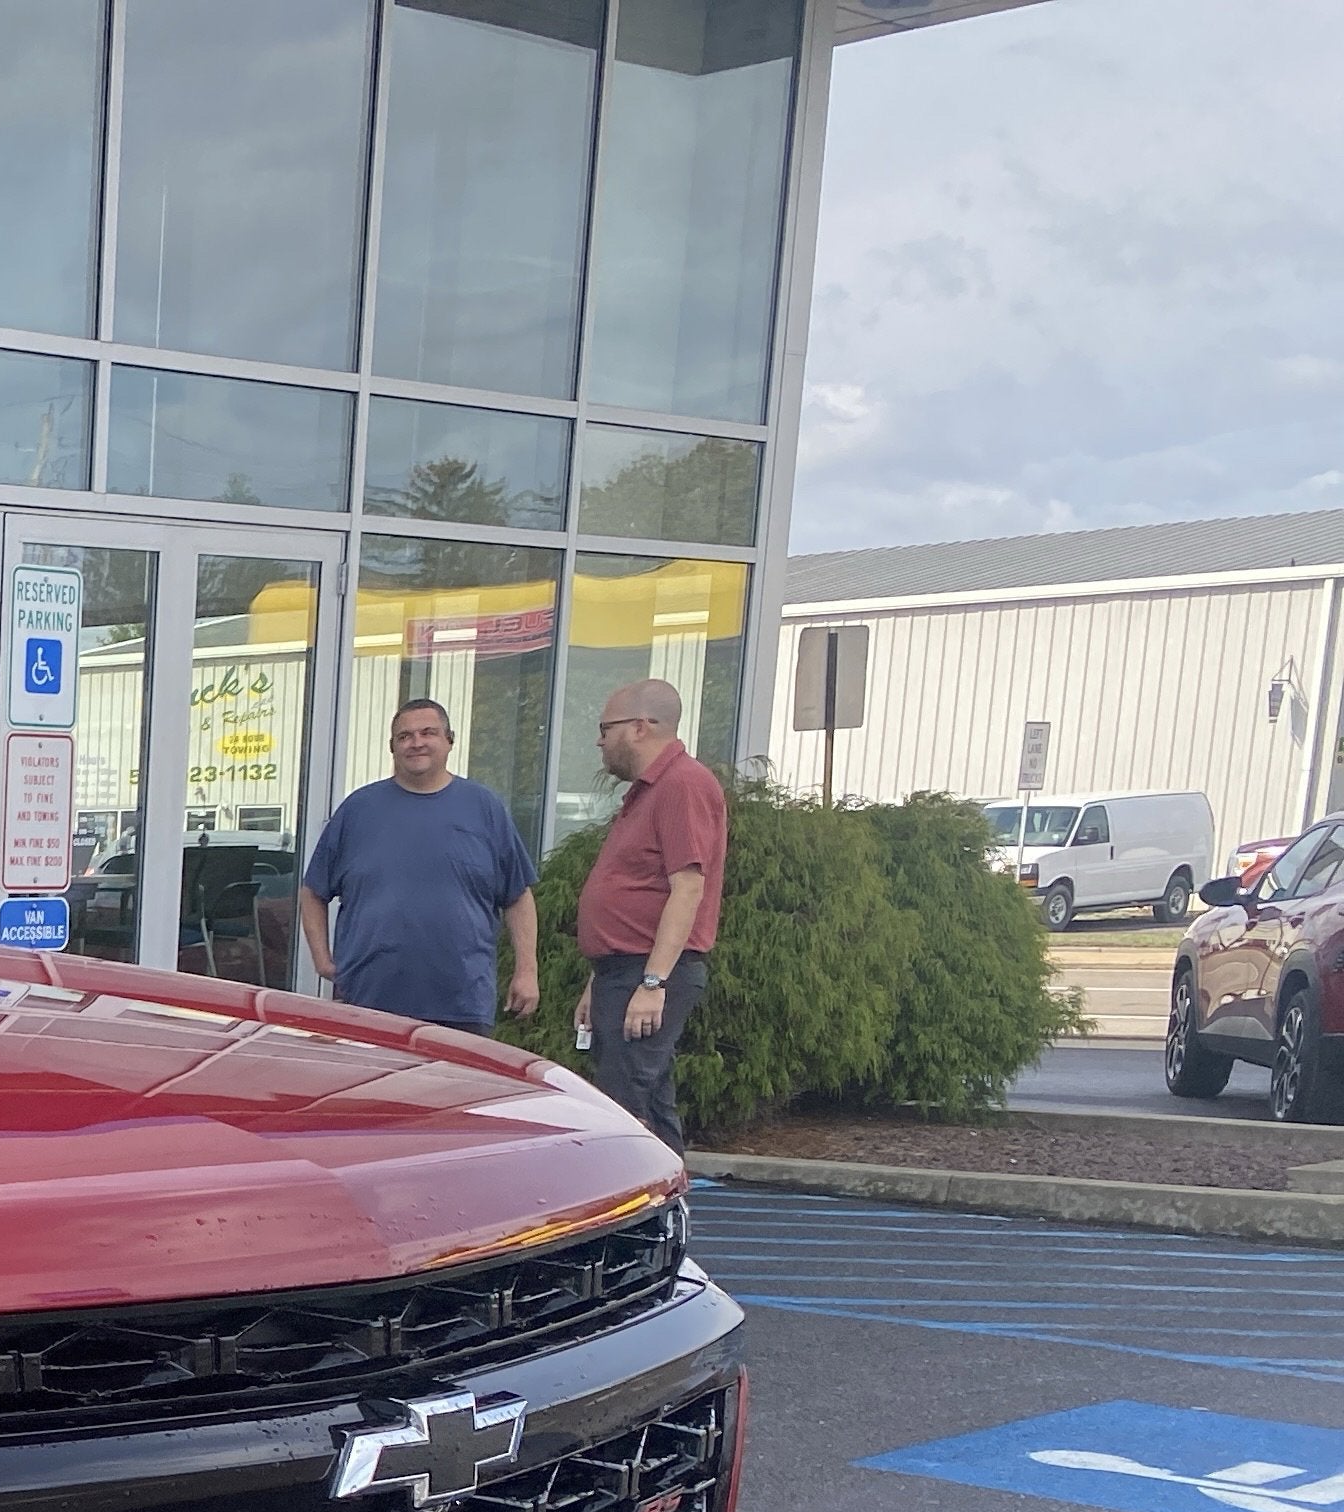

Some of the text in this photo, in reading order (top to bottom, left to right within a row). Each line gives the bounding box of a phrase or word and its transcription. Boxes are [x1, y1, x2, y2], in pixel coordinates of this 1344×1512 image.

[17, 580, 76, 605] RESERVED
[18, 609, 73, 632] PARKING
[223, 744, 272, 755] TOWING
[21, 756, 60, 768] VIOLATORS
[24, 775, 55, 785] SUBJECT
[23, 792, 54, 804] TO FINE
[17, 811, 59, 822] AND TOWING
[29, 838, 44, 849] FINE
[47, 838, 60, 849] $50
[26, 856, 41, 866] FINE
[44, 856, 63, 867] $200
[24, 910, 45, 924] VAN
[1, 925, 65, 941] ACCESSIBLE
